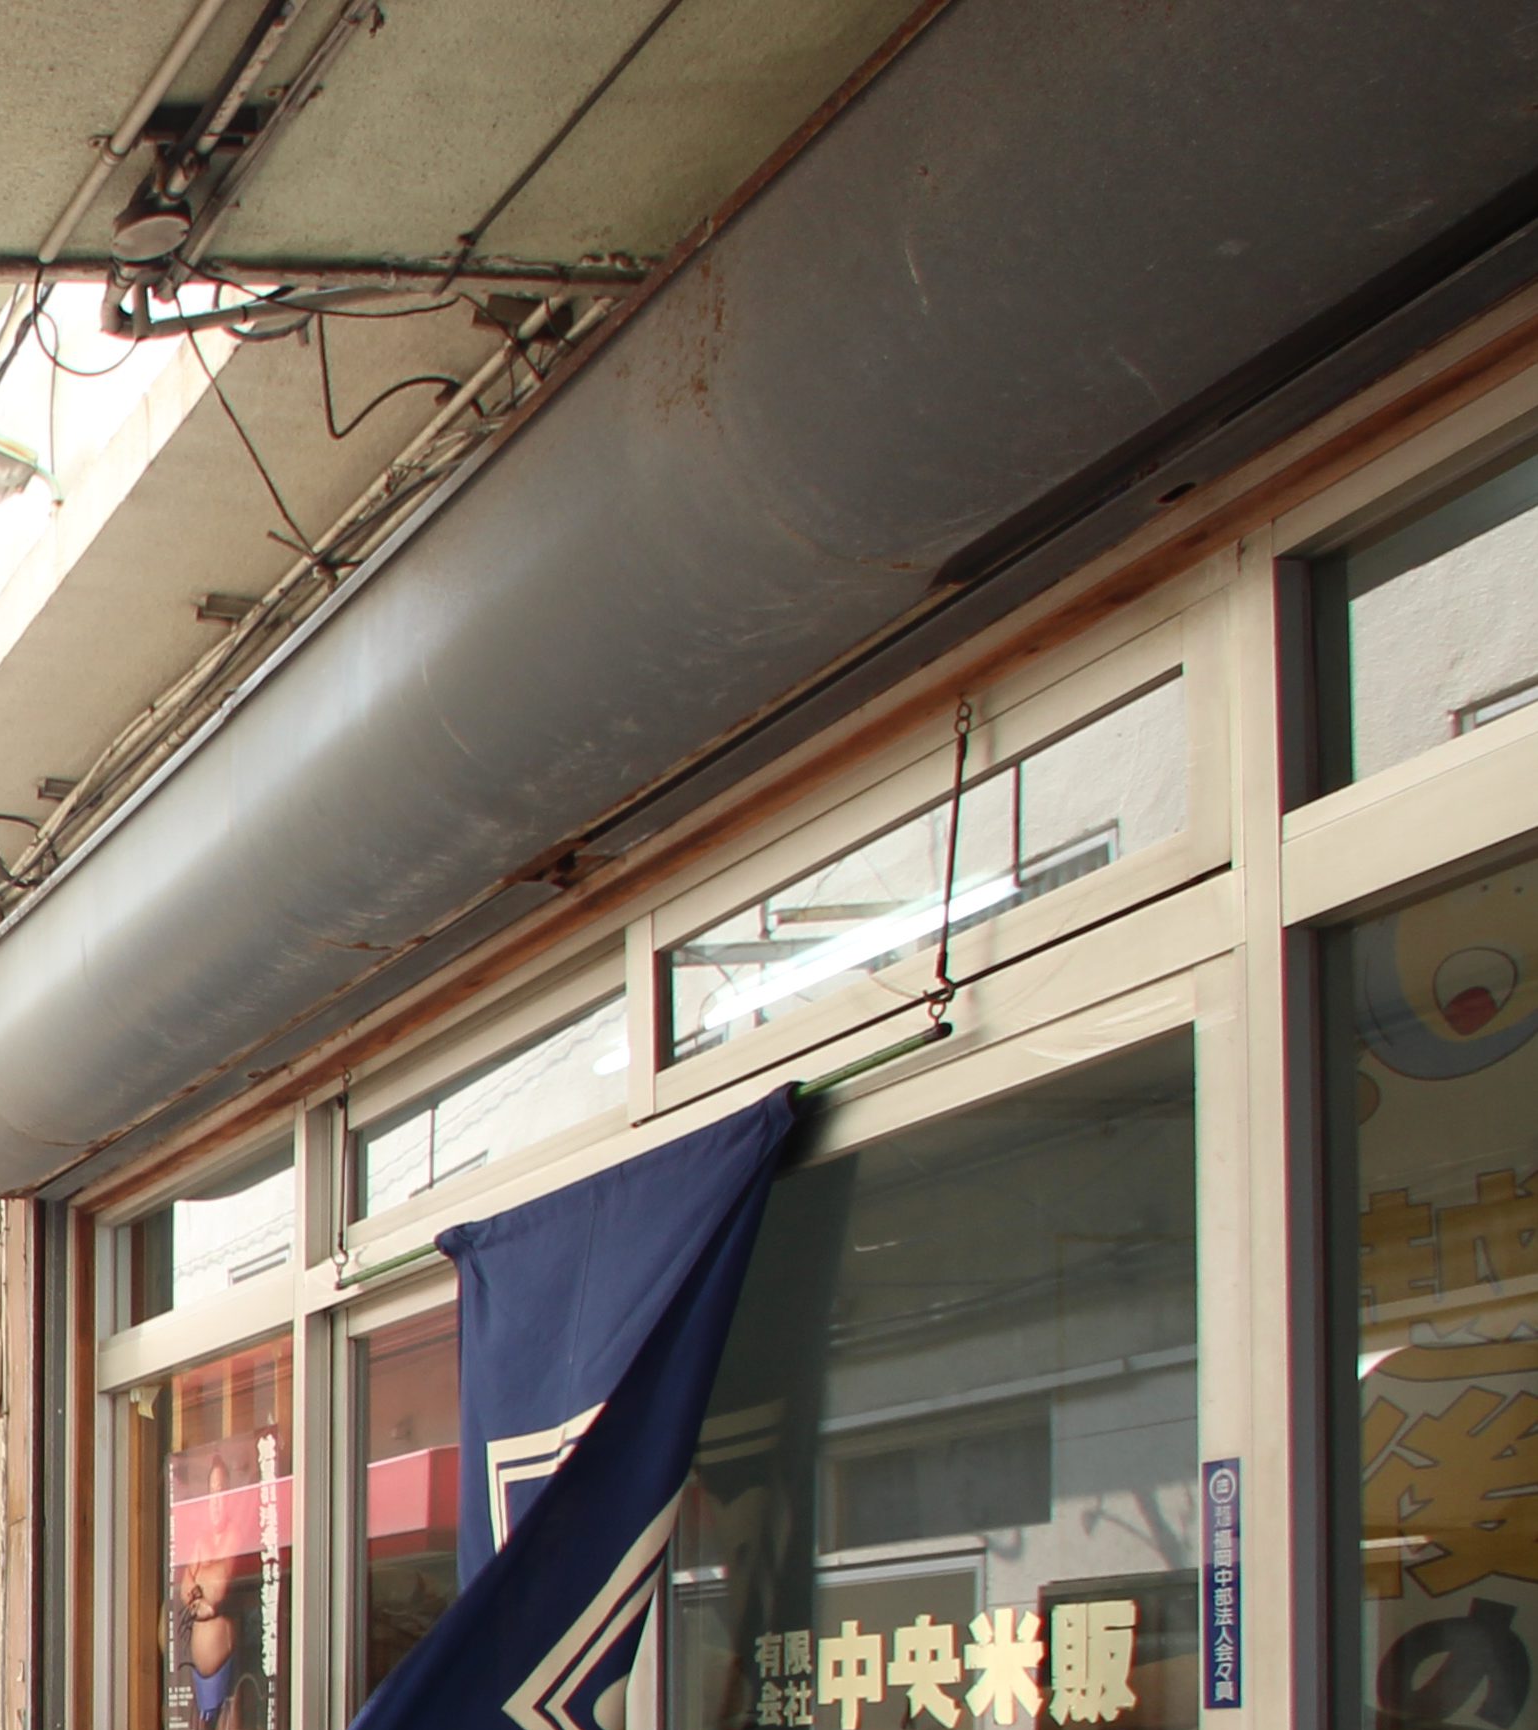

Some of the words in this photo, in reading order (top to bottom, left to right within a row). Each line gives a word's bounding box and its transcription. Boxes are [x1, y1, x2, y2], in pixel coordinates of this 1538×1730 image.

[755, 1630, 812, 1678] 有限
[817, 1600, 1136, 1730] 中央米販
[756, 1680, 813, 1727] 会社
